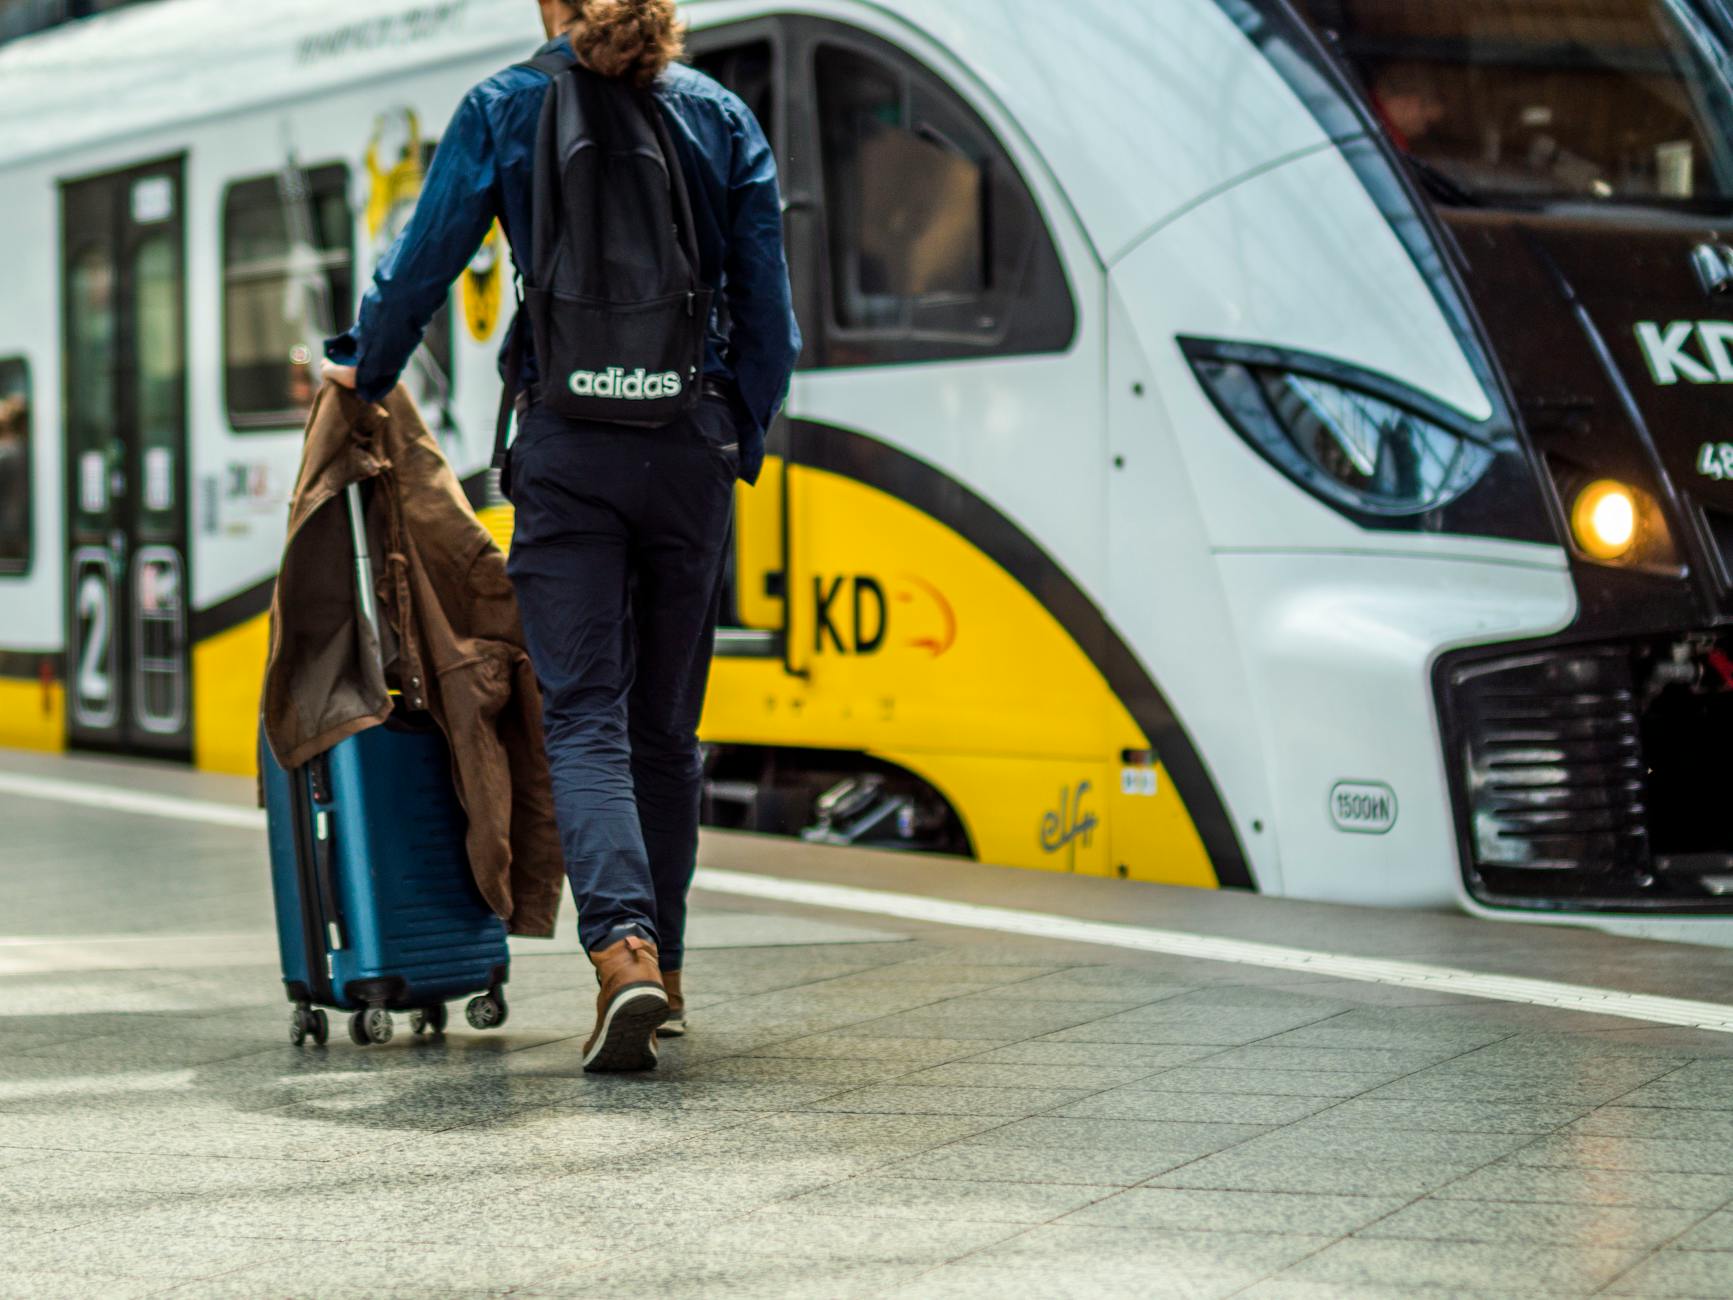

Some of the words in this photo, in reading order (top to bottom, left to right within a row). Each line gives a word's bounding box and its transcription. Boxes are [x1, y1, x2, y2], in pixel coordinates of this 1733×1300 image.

[568, 366, 682, 400] adidas
[78, 574, 112, 701] 2
[813, 575, 888, 656] KD
